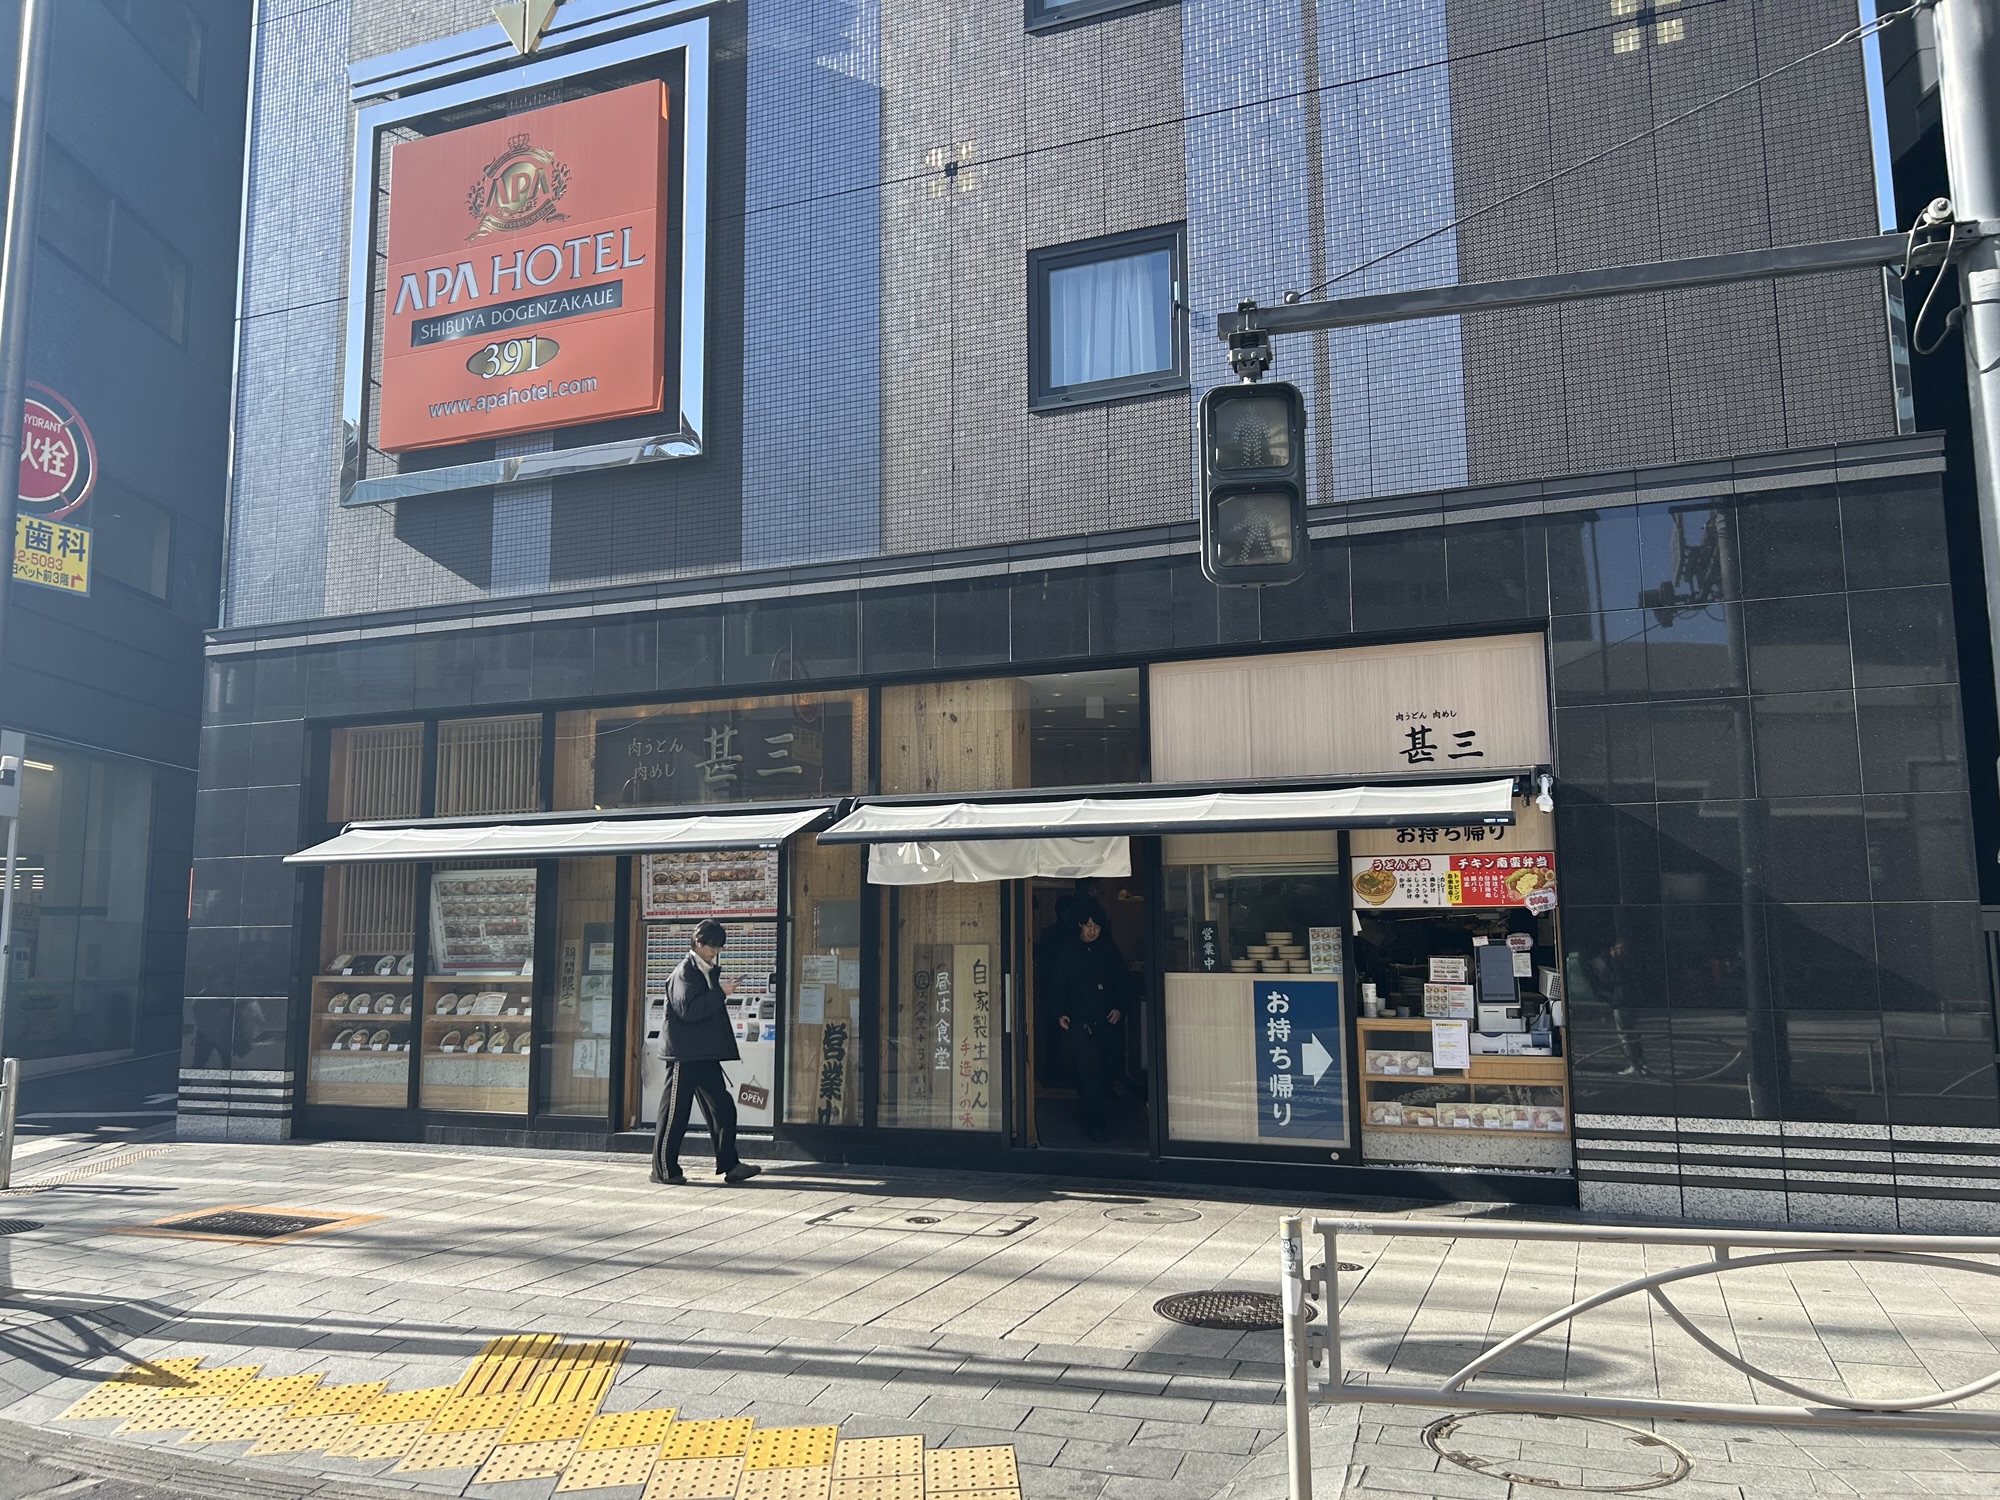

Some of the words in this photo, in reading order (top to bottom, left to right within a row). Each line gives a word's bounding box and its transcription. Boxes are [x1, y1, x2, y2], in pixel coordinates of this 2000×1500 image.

[393, 260, 479, 315] APA
[490, 227, 646, 295] HOTEL
[420, 313, 485, 340] SHIBUYA
[491, 289, 614, 325] DOGENZAKAUE
[482, 335, 540, 379] 391
[428, 376, 598, 418] www.apahotel.com
[14, 550, 63, 571] 2-5083
[16, 517, 86, 562] 歯科
[1432, 710, 1457, 719] 肉めし
[694, 724, 803, 783] 甚三
[1399, 724, 1483, 764] 甚三
[634, 761, 676, 780] 肉めし
[1372, 858, 1431, 871] うどん弁当
[1457, 856, 1548, 869] チキン南蛮弁当
[1201, 927, 1215, 970] 営業中
[934, 972, 951, 1070] 昼は食堂
[971, 959, 989, 1109] 自家製生めん
[1266, 990, 1294, 1126] お持ち帰り
[741, 1091, 764, 1105] OPEN
